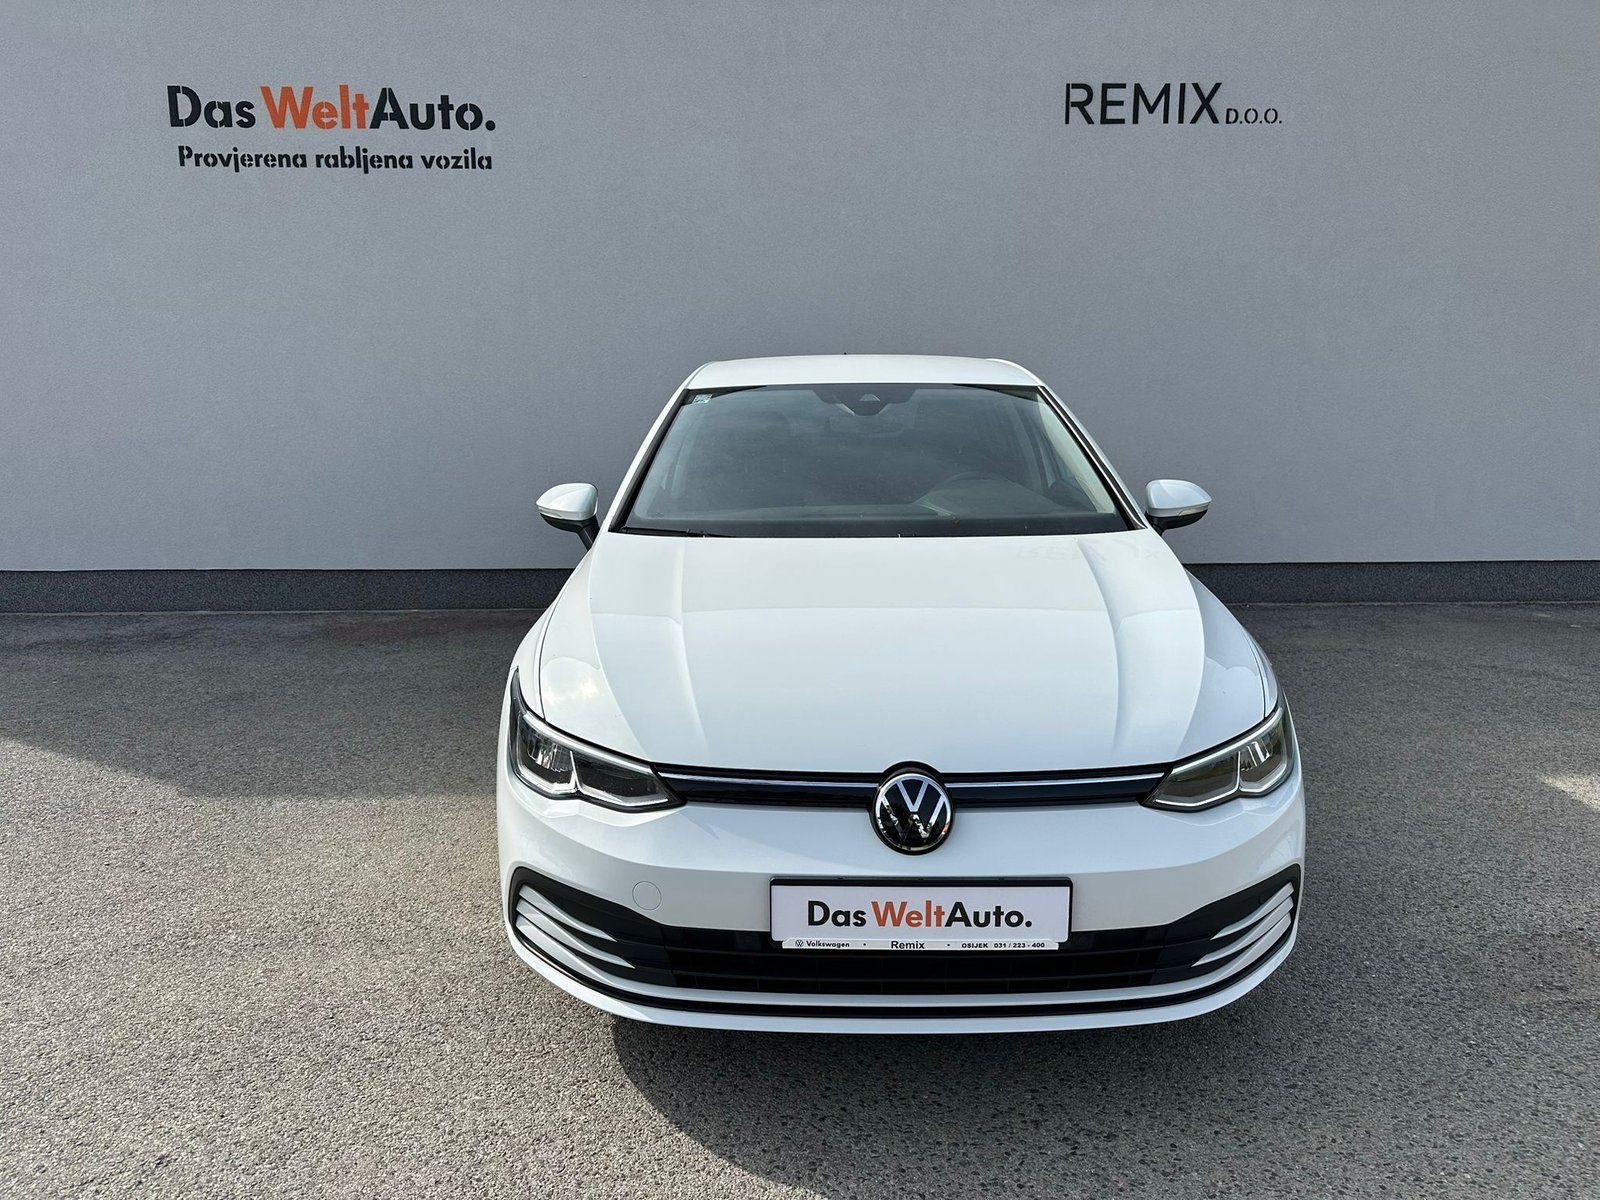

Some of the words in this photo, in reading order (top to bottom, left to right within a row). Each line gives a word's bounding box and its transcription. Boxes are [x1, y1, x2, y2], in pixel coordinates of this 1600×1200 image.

[167, 85, 256, 128] Das
[260, 84, 496, 131] WeltAuto.
[1064, 82, 1222, 125] REMIX
[1225, 108, 1283, 124] D.O.O.
[178, 145, 307, 172] Provjerena
[315, 146, 413, 174] rabljena
[420, 147, 493, 170] vozila
[807, 900, 867, 927] Das
[871, 900, 1033, 928] WeltAuto.
[806, 940, 850, 948] Volkswagen
[890, 940, 925, 950] Remix
